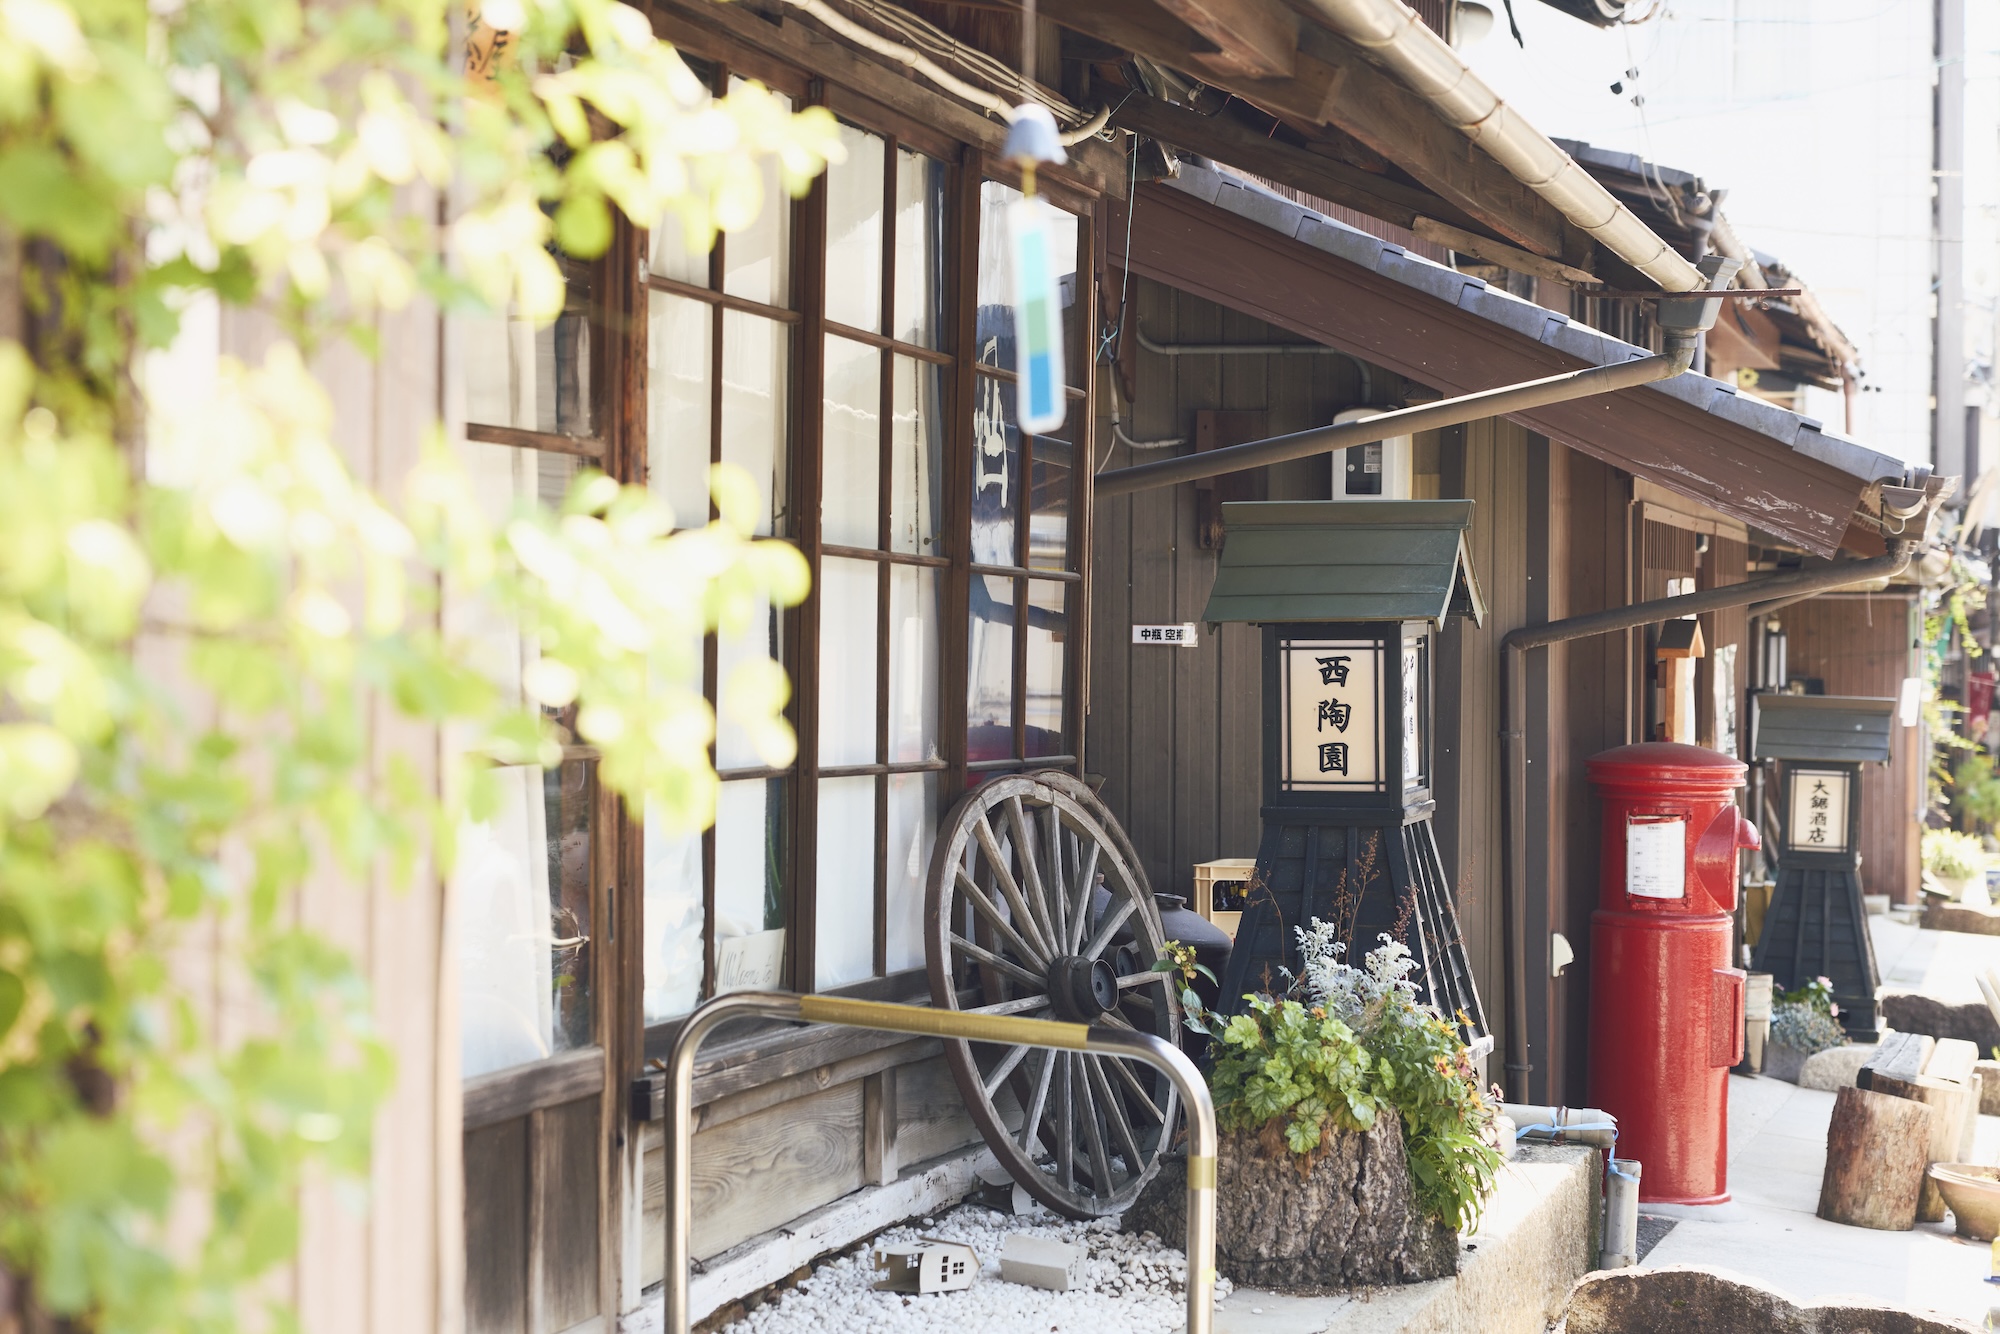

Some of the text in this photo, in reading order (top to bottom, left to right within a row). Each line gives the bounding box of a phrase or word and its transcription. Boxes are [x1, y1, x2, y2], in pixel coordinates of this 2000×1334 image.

[1141, 628, 1162, 641] 中瓶
[1315, 655, 1352, 777] 西陶園
